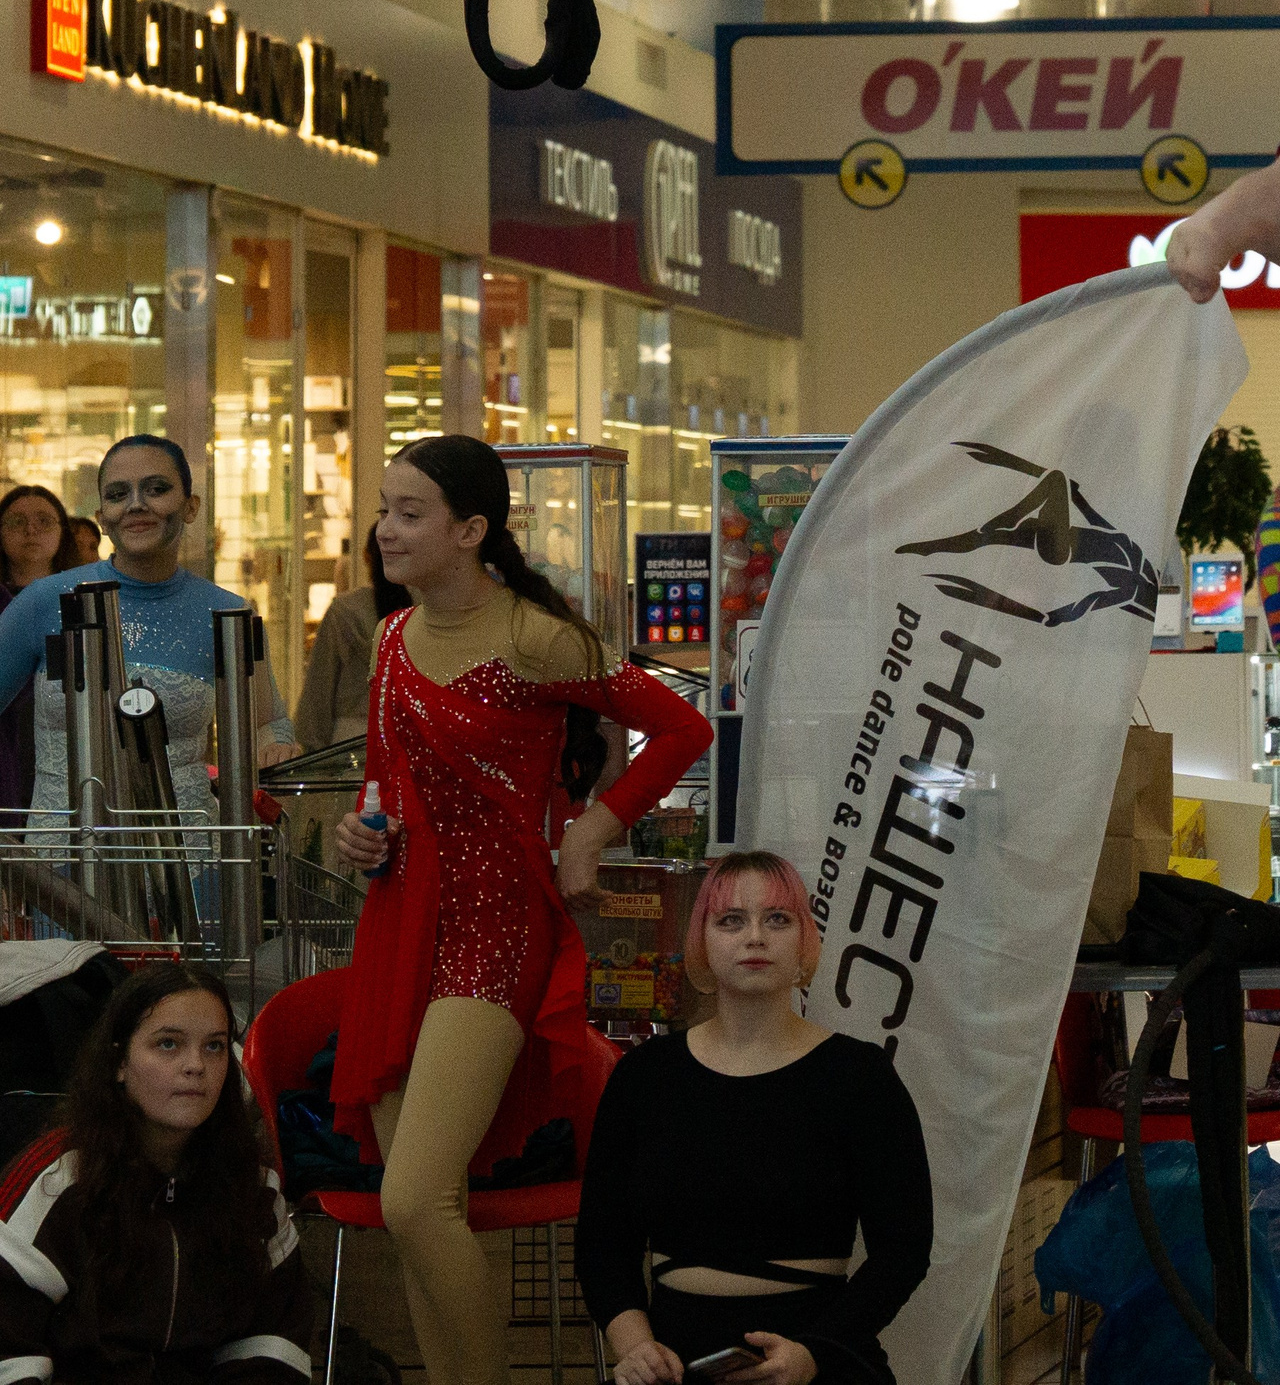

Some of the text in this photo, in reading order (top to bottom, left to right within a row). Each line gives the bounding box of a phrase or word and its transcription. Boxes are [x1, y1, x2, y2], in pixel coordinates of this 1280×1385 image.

[52, 22, 80, 57] LAND
[859, 39, 1185, 134] О'КЕЙ
[510, 506, 535, 514] ЫГУН
[881, 603, 921, 682] pole
[845, 689, 896, 795] dance
[833, 802, 862, 828] &
[834, 629, 1002, 1064] НАШЕС
[611, 896, 653, 905] ОНФЕТЫ
